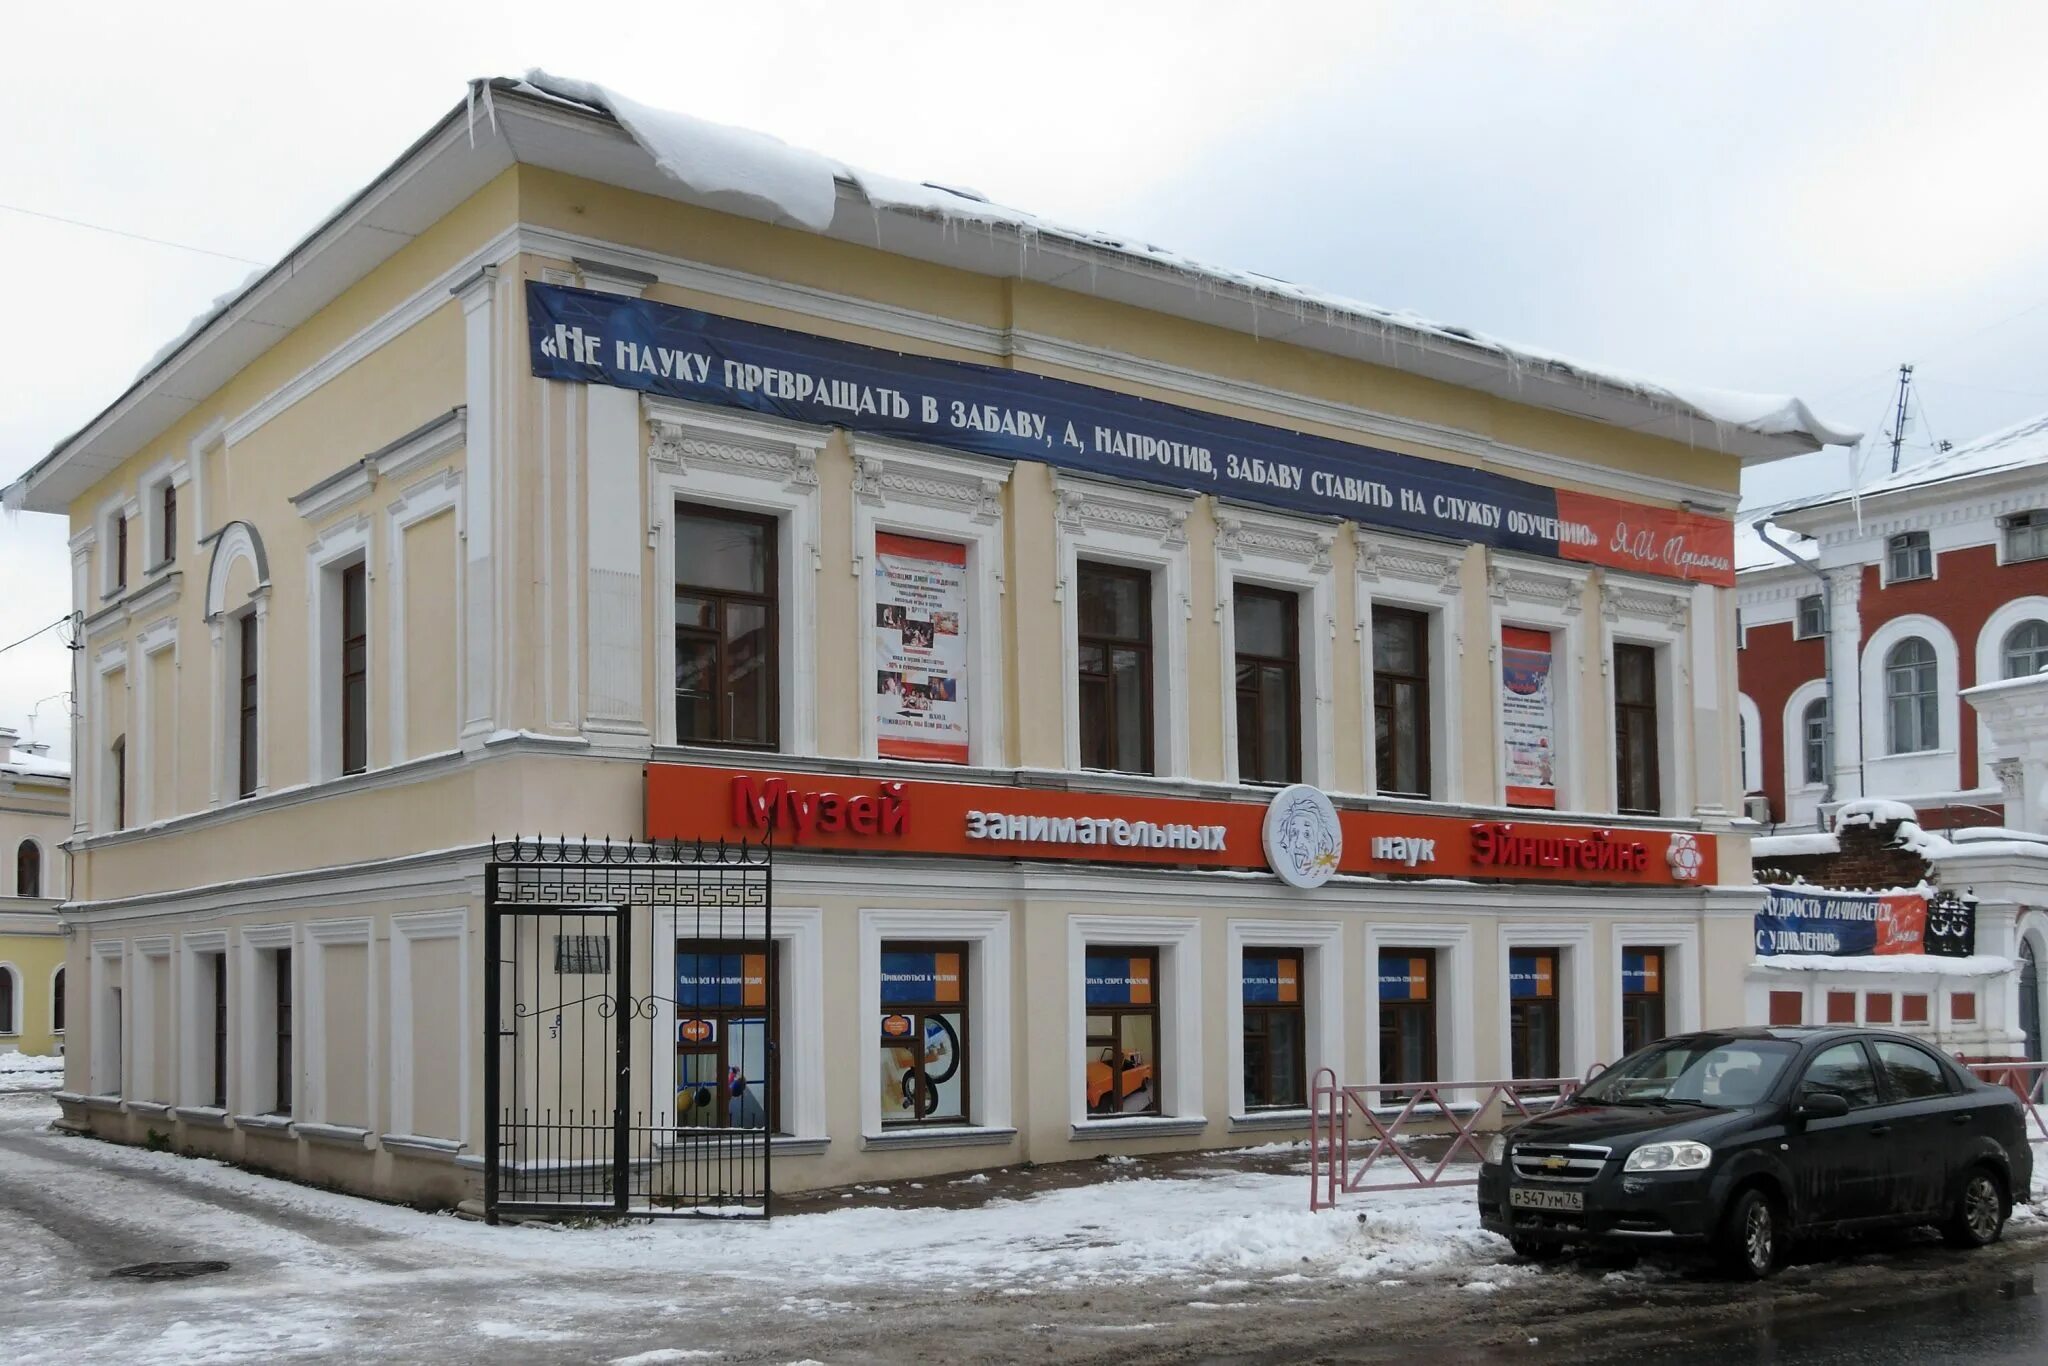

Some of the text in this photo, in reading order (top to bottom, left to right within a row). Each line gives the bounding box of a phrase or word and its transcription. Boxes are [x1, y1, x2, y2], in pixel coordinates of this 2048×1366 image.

[615, 340, 711, 384] НАУКУ
[724, 359, 910, 419] ПРЕВРАЩАТЬ
[921, 395, 939, 424] В
[950, 400, 1053, 449] ЗАБАВУ,
[1063, 420, 1085, 454] А,
[1094, 426, 1218, 481] НАПРОТИВ,
[1226, 454, 1304, 491] ЗАБАВУ
[1311, 471, 1394, 508] СТАВИТЬ
[1400, 488, 1426, 515] НА
[1433, 495, 1502, 529] СЛУЖБУ
[1507, 509, 1598, 546] ОБУЧЕНИЮ»
[731, 774, 1650, 872] Музей занимательных наук Эйнштейна
[1756, 929, 1765, 949] С
